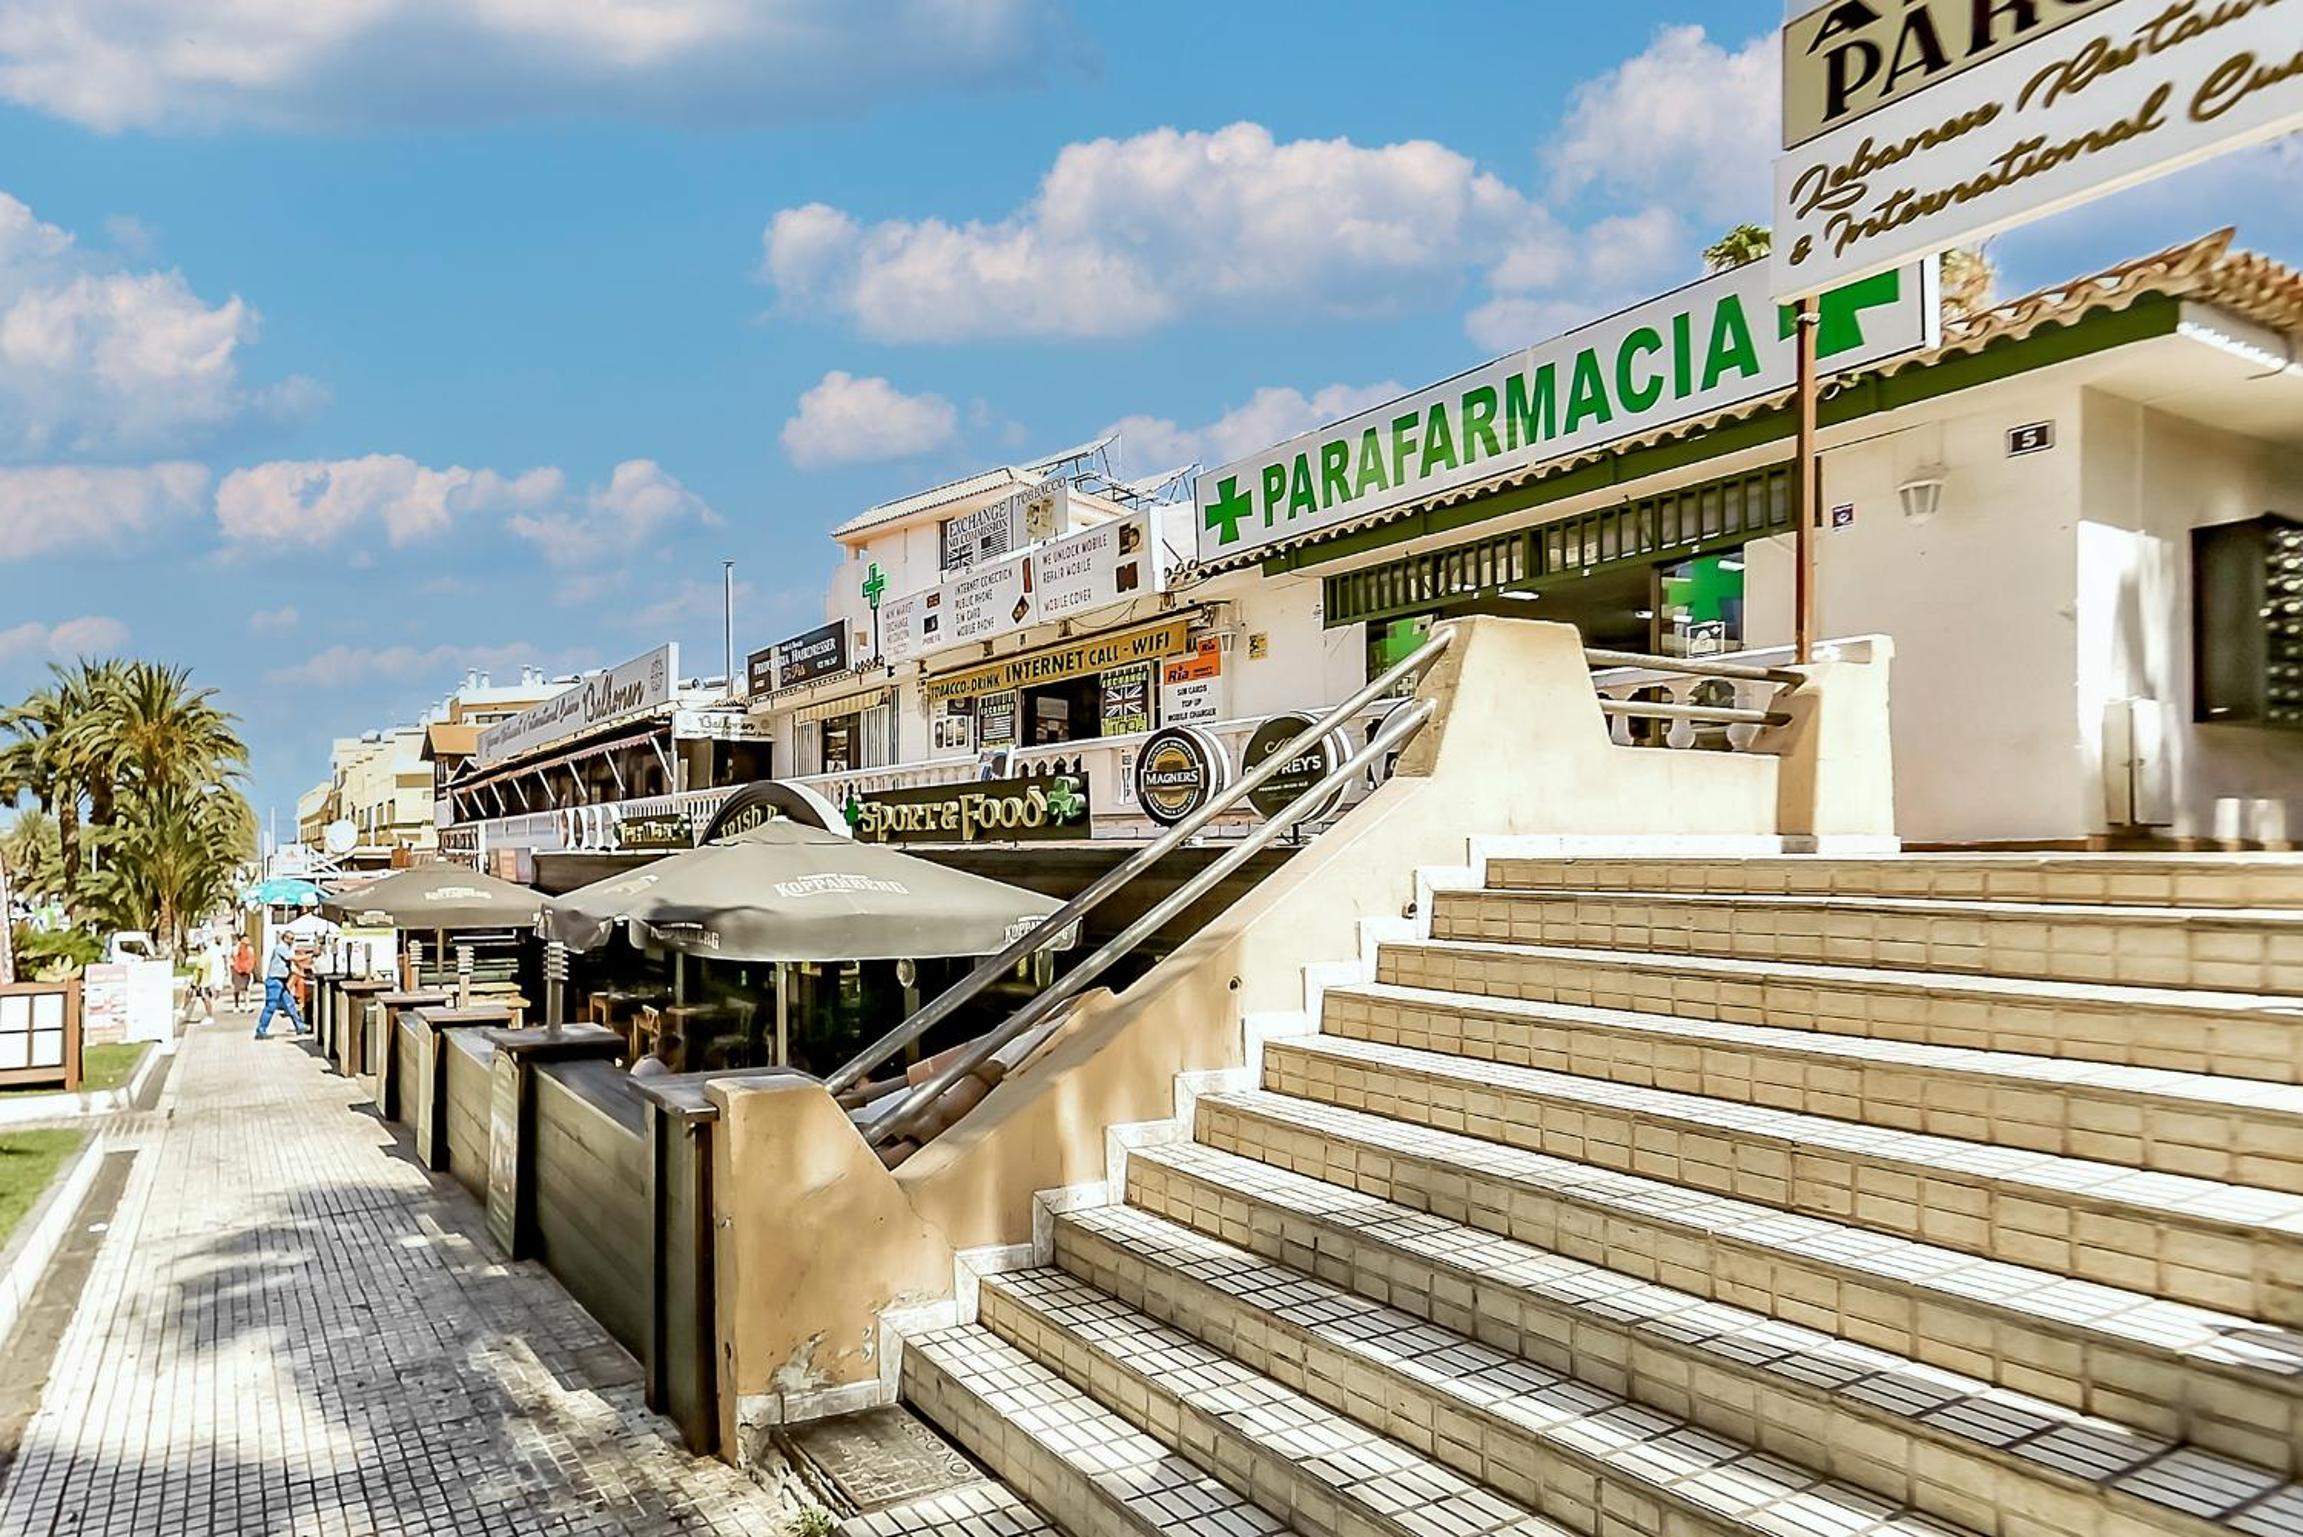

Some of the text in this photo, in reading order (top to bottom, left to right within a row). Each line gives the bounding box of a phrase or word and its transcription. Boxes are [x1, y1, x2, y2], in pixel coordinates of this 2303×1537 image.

[1822, 0, 2093, 123] PAR
[1790, 102, 2003, 219] Lebanese
[1824, 82, 2171, 258] International
[1262, 294, 1759, 528] PARAFARMACIA
[2021, 430, 2038, 448] 5
[1015, 477, 1066, 506] TOBACCO
[948, 502, 1006, 538] EXCHANGE
[1053, 543, 1080, 563] UNLOCK
[1082, 533, 1107, 554] MOBILE
[1066, 557, 1091, 577] MOBILE
[1006, 651, 1084, 683] INTERNET
[1088, 645, 1118, 667] CALL
[1132, 631, 1170, 655] WIFI
[1168, 665, 1189, 682] Ria
[1145, 769, 1199, 785] MAGNERS
